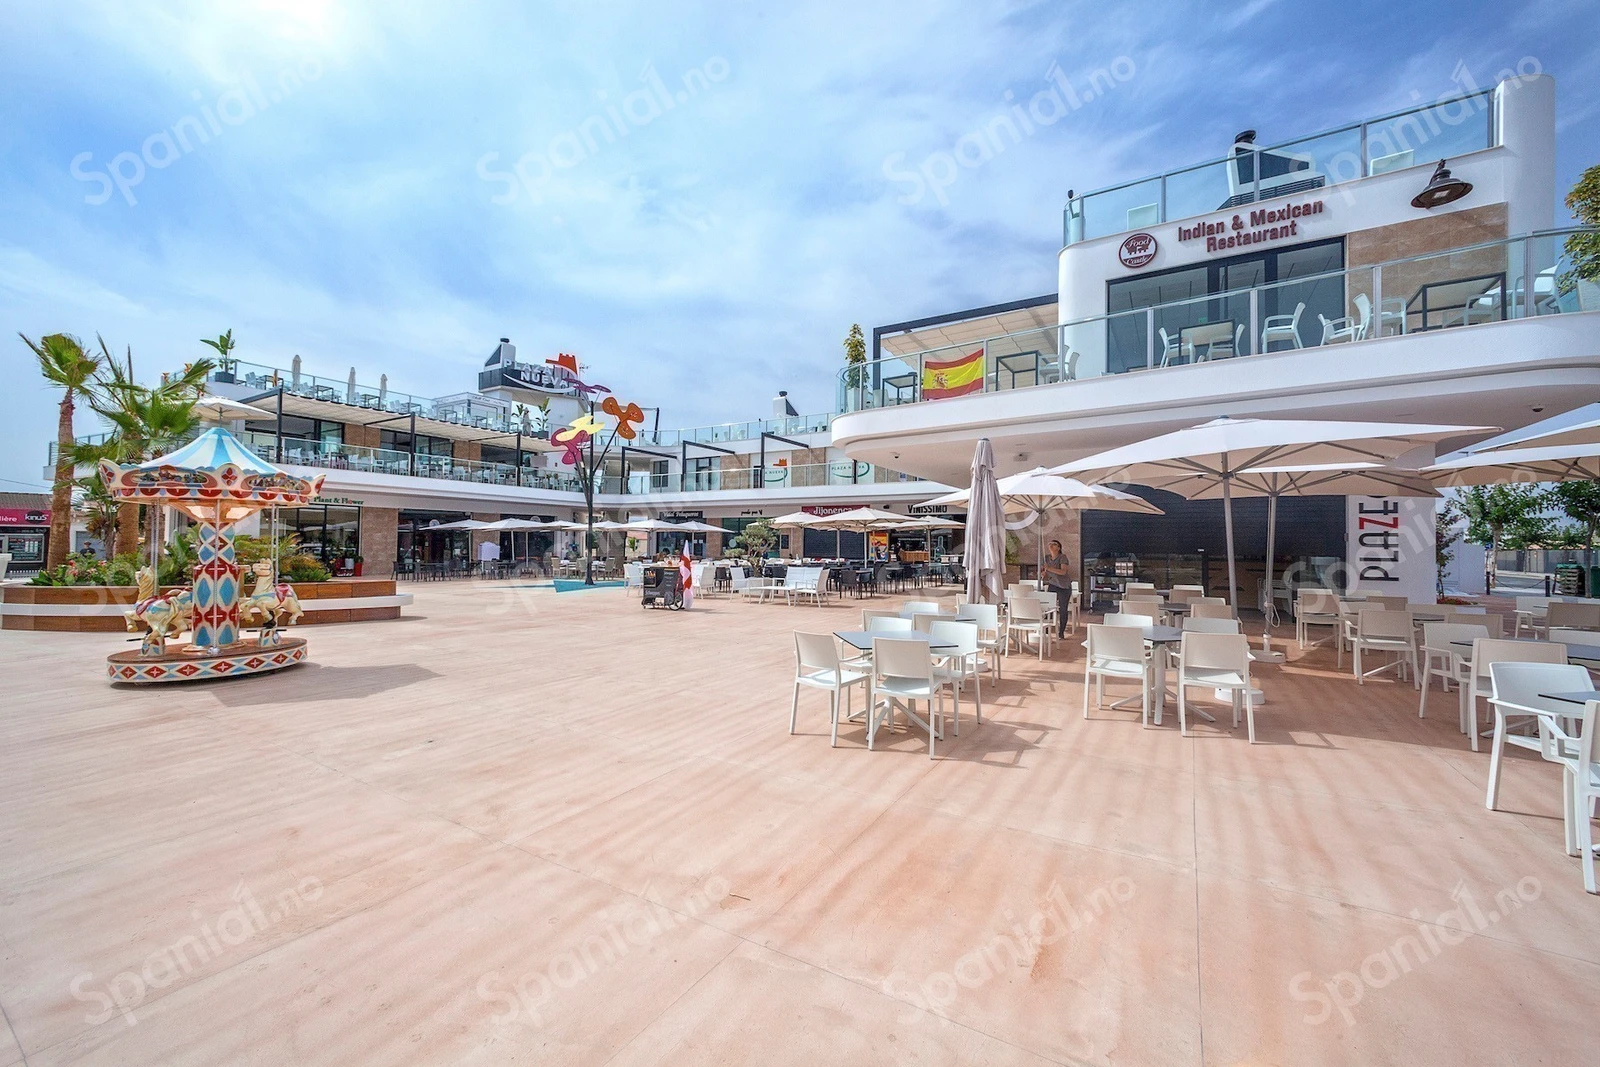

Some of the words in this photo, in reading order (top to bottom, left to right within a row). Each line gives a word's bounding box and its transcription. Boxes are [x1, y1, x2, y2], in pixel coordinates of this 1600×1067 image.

[1177, 221, 1225, 242] Indian
[1231, 214, 1244, 231] &
[1250, 200, 1323, 227] Mexican
[1126, 237, 1150, 248] Food
[1206, 220, 1297, 252] Restaurant
[504, 359, 552, 375] PLAZA
[520, 371, 568, 387] NUEVA
[341, 497, 364, 505] Flower
[1358, 495, 1399, 581] PLAZE
